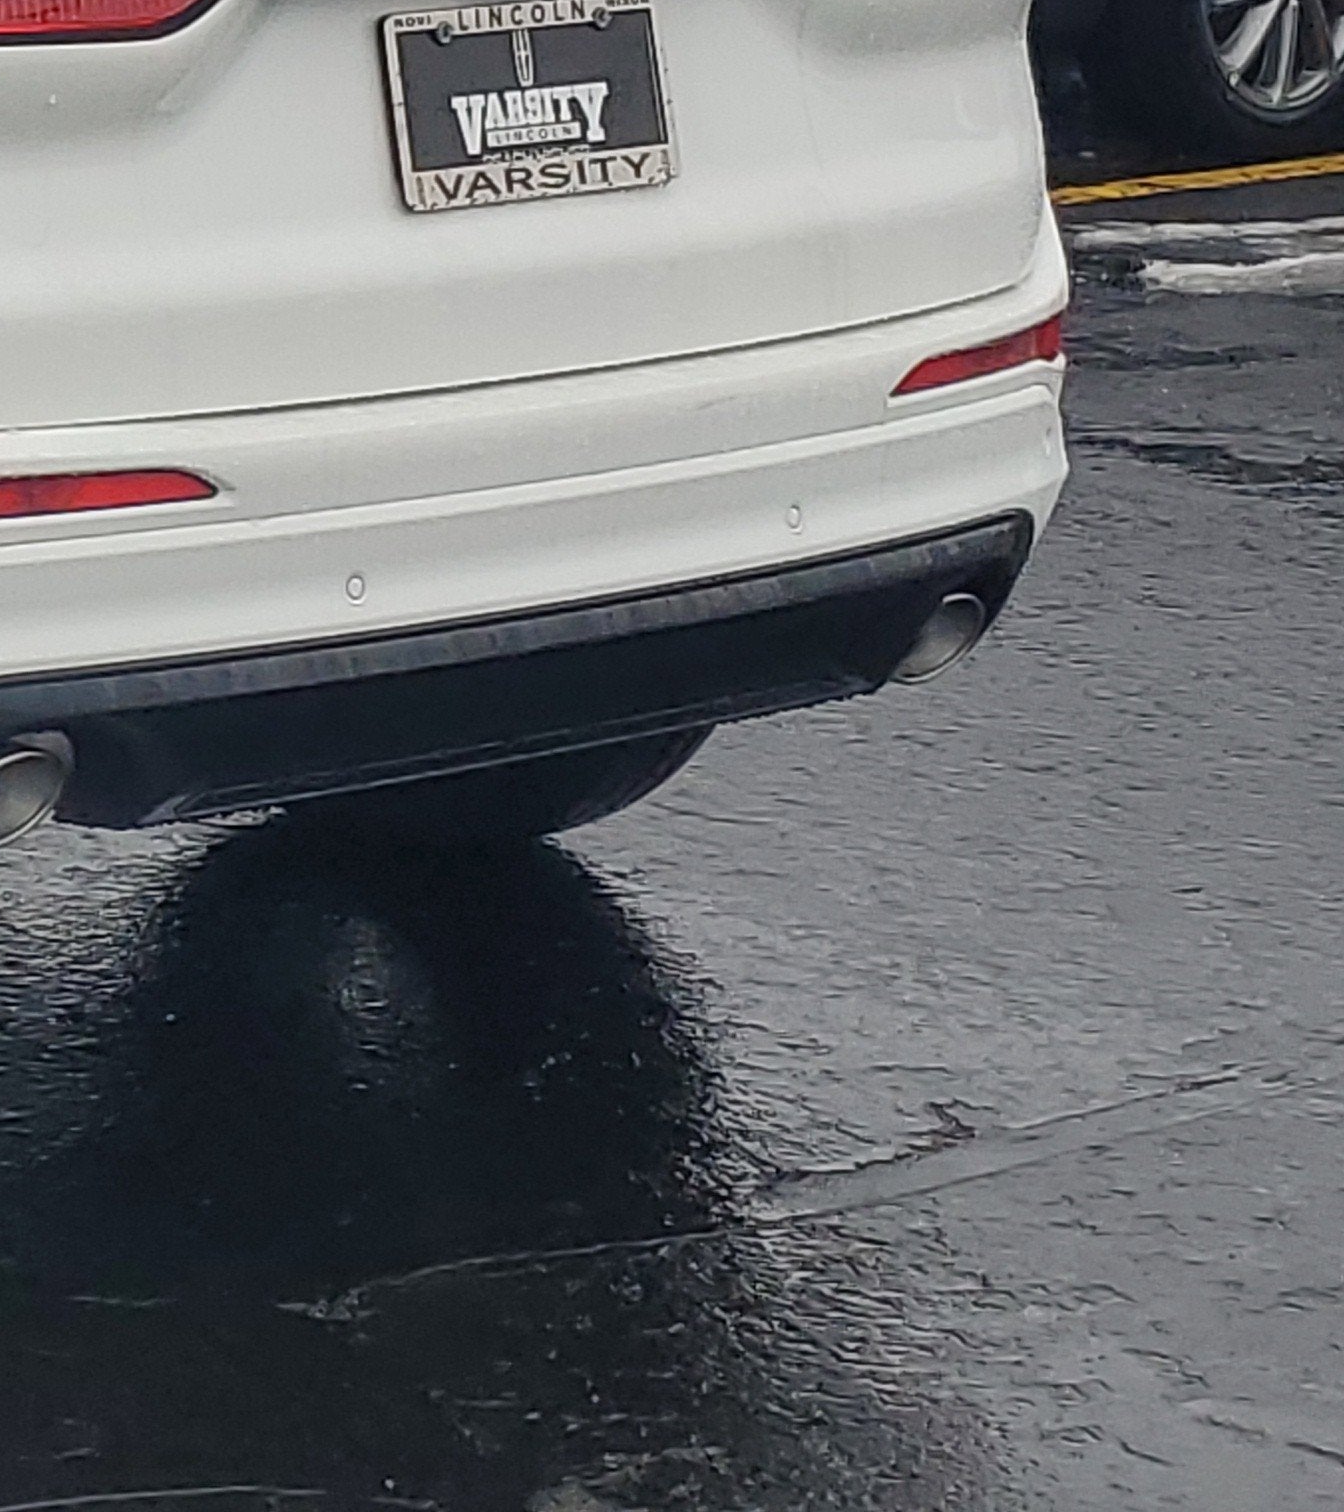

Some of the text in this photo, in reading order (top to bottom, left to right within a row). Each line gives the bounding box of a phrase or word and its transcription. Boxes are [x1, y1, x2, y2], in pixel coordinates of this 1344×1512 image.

[456, 0, 587, 31] LINCOLN
[450, 82, 609, 156] VARSITY
[495, 126, 572, 144] LINCOLN
[434, 151, 652, 201] VARSITY
